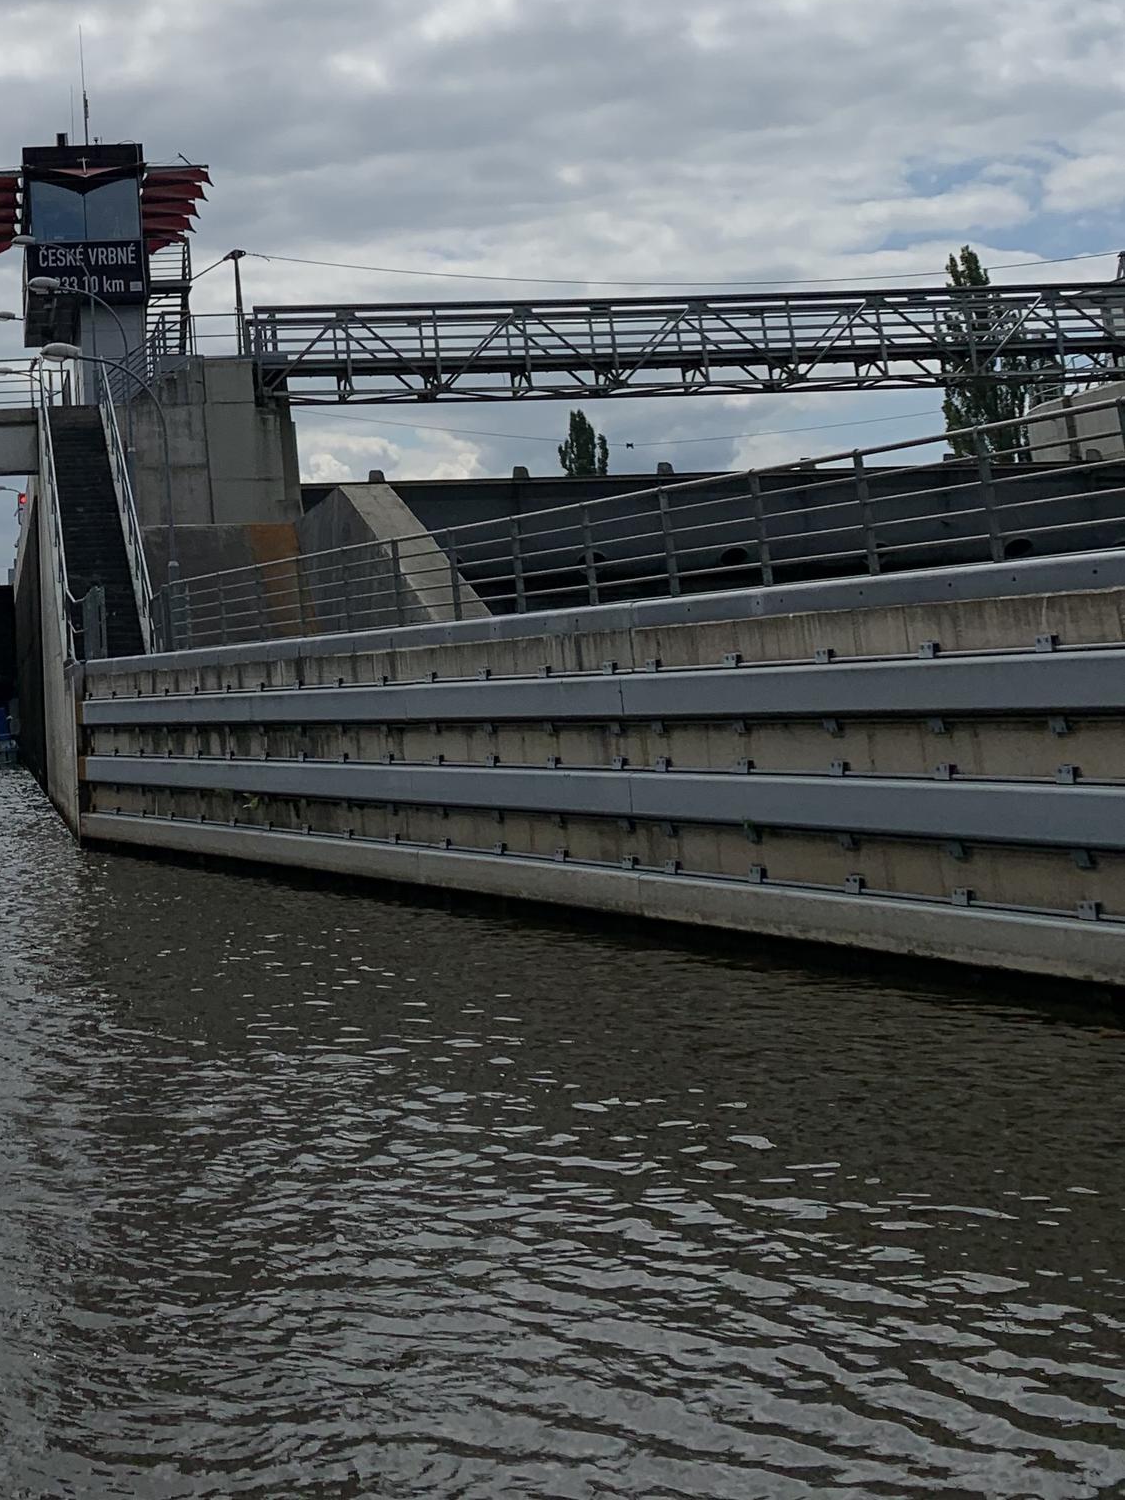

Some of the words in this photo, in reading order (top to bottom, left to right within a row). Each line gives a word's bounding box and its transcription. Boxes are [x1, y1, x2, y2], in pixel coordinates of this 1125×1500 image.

[39, 245, 84, 267] ČESKÉ
[88, 243, 136, 266] VRBNÉ
[103, 275, 125, 293] km
